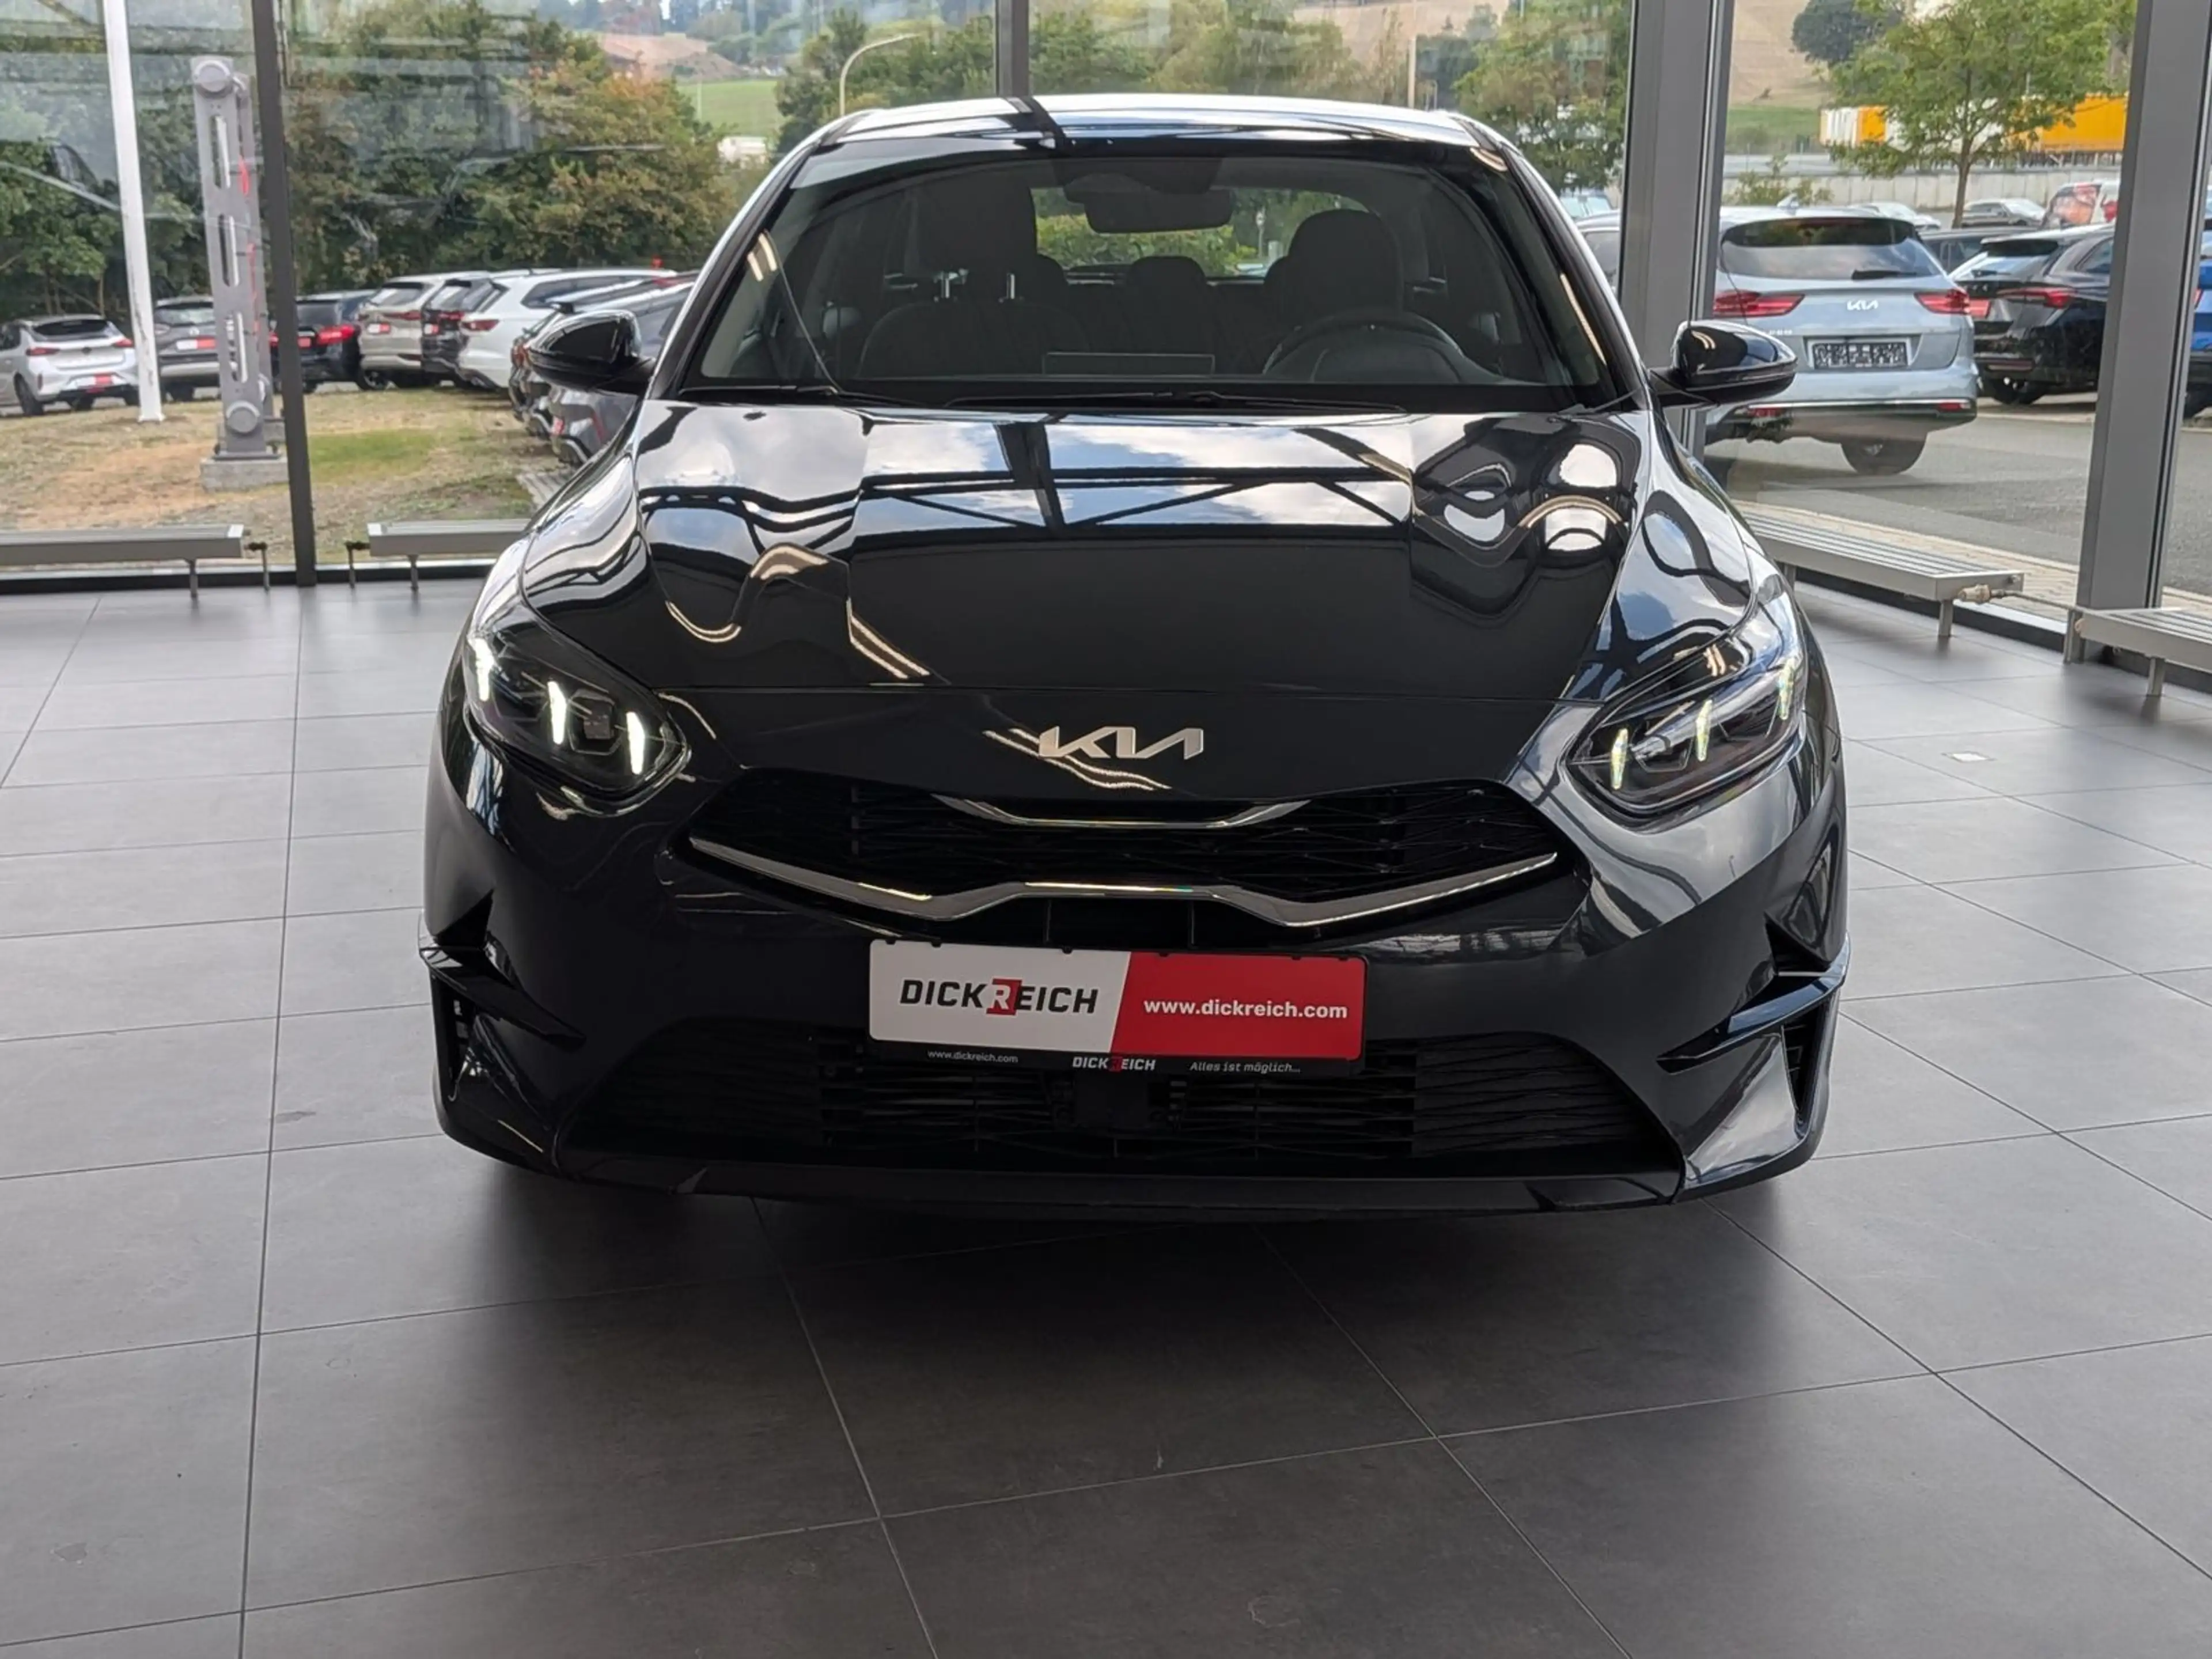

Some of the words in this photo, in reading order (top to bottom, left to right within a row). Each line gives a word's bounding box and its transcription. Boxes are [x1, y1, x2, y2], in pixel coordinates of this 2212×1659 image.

[1847, 300, 1878, 310] KIA
[1039, 726, 1203, 759] KIA
[900, 978, 1099, 1015] DICKREICH
[1144, 999, 1348, 1018] www.dickreich.com
[927, 1050, 1018, 1063] www.dickreich.com
[1190, 1062, 1221, 1071] Alles
[1223, 1062, 1241, 1071] ist
